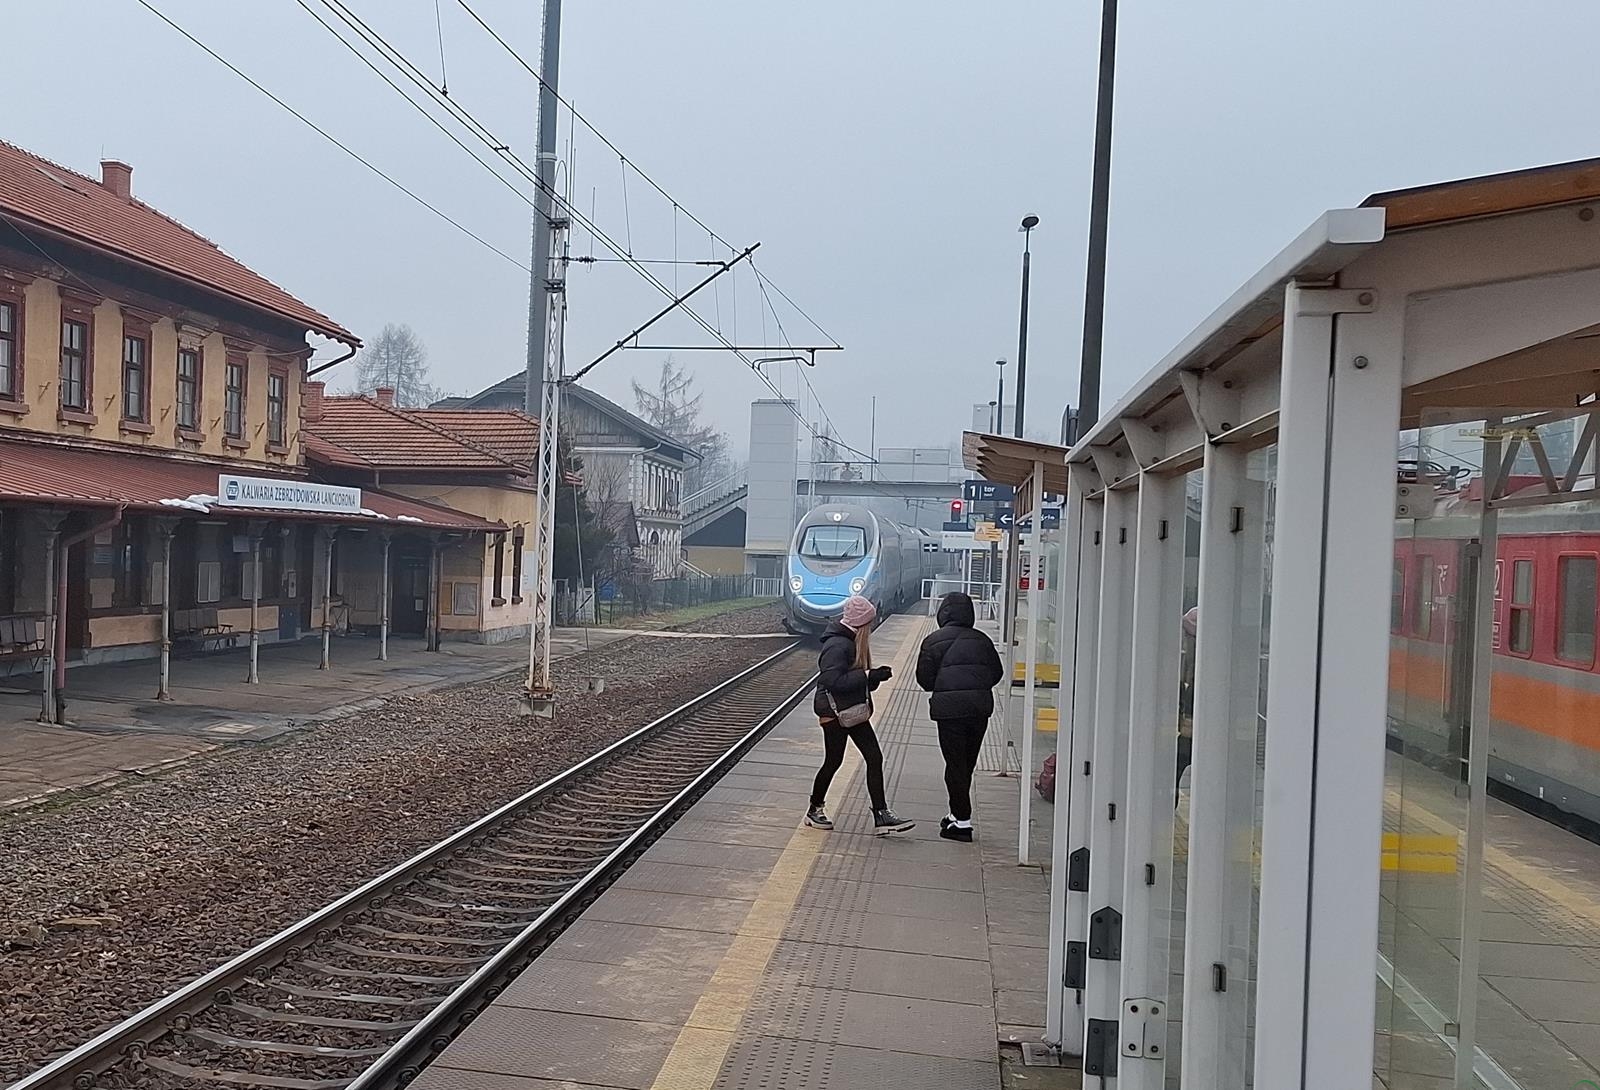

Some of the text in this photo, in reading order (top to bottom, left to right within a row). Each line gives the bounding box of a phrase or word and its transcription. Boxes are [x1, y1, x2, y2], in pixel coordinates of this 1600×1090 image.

[241, 484, 356, 507] KALWARIA ZEBRZYDOWSKA LANCKORONA
[970, 485, 976, 498] 1
